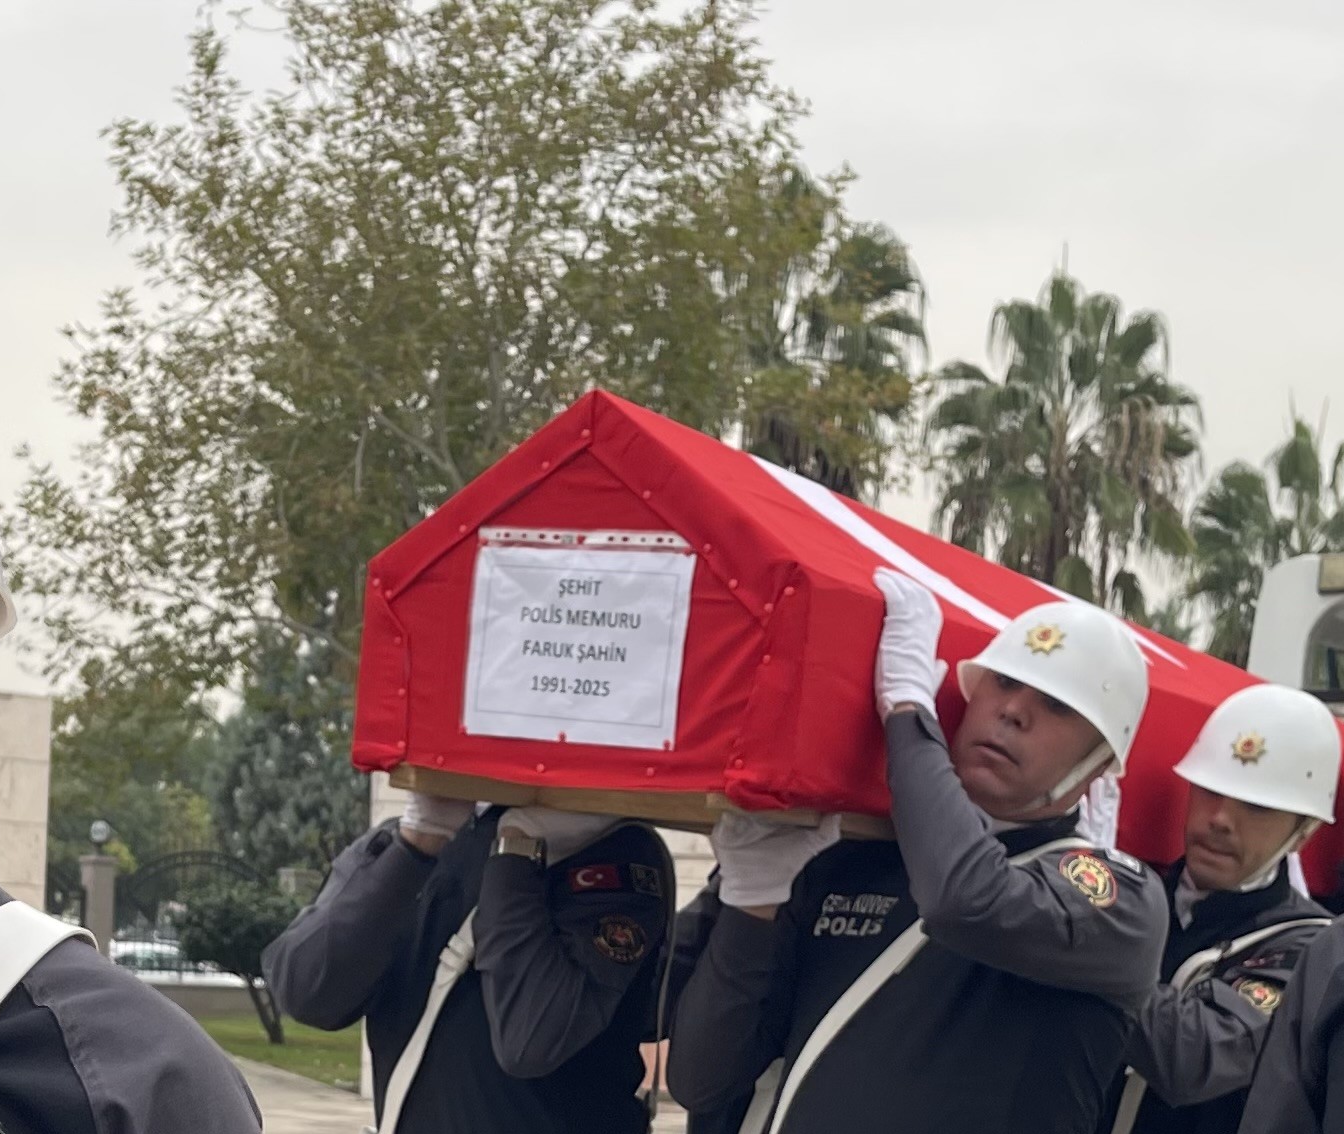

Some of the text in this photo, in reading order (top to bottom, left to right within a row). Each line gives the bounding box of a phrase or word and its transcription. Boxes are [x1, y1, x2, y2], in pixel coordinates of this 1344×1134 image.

[559, 577, 602, 597] ŞEHİT
[521, 604, 641, 629] POLİS MEMURU
[522, 640, 626, 663] FARUK ŞAHİN
[531, 675, 610, 697] 1991-2025
